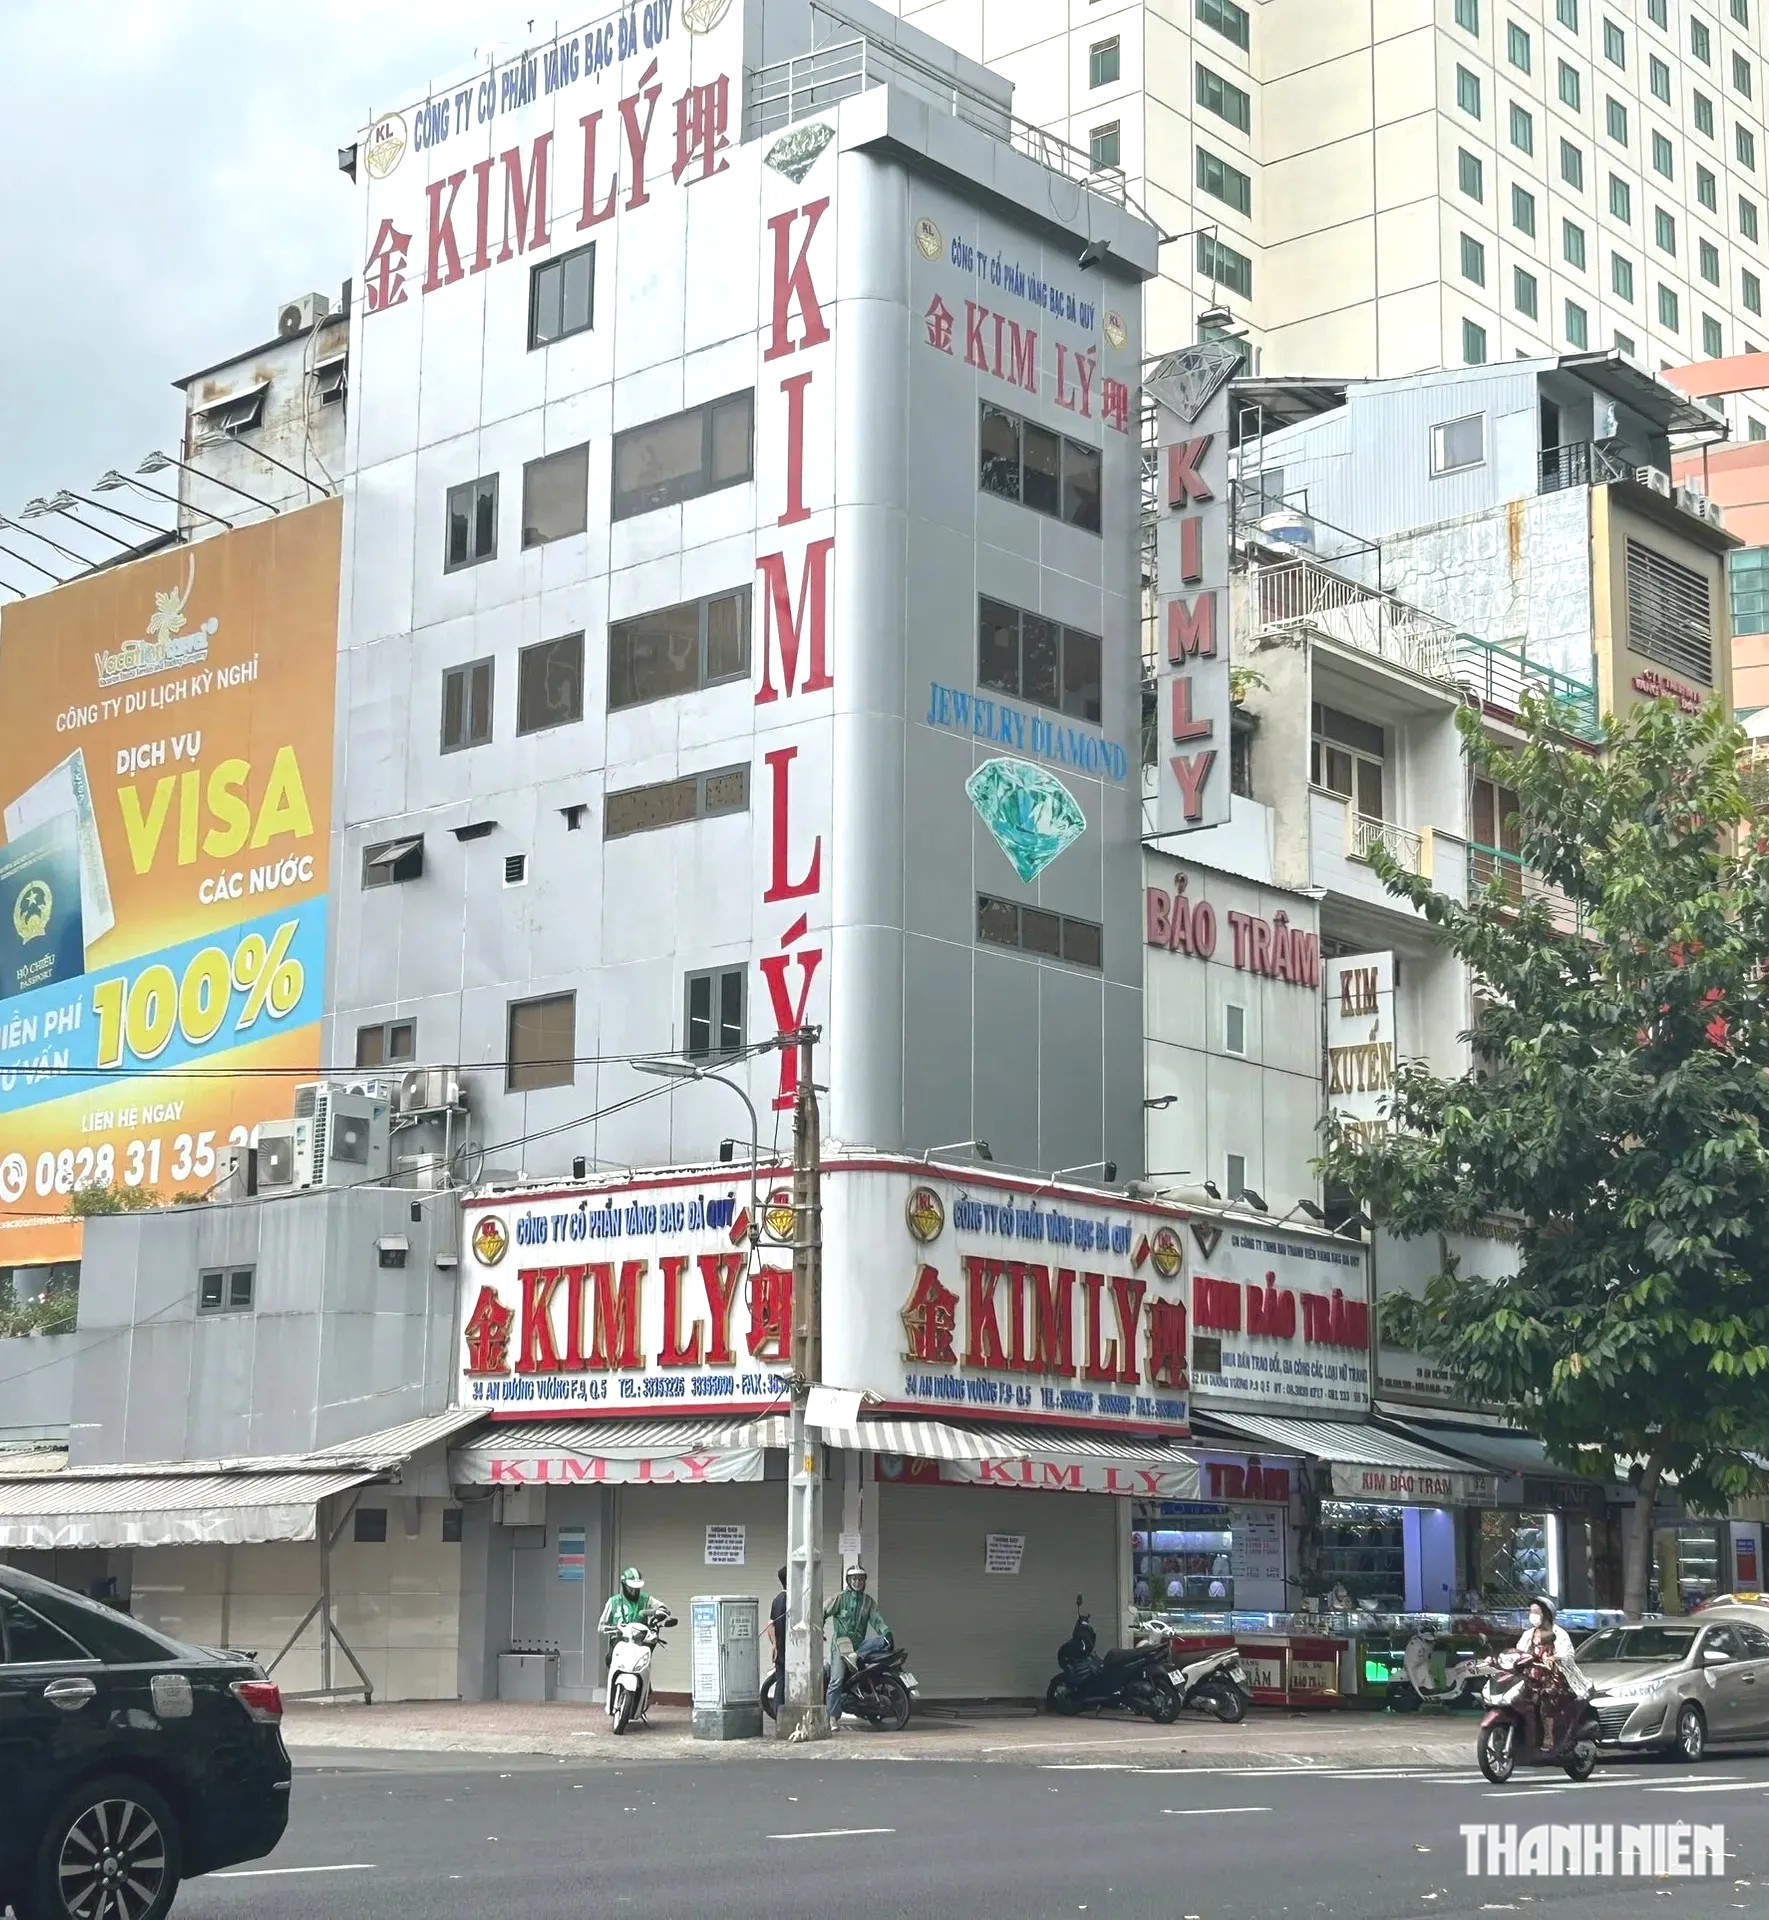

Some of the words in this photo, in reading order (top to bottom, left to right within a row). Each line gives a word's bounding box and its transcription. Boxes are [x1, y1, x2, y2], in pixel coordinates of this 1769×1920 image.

[455, 88, 474, 135] TY
[585, 22, 613, 84] BẠC
[375, 123, 394, 141] KL
[673, 73, 730, 187] 理
[422, 131, 554, 295] KIM
[577, 57, 663, 232] LÝ
[363, 218, 412, 318] 金
[977, 251, 987, 280] TY
[924, 293, 954, 356] 金
[964, 299, 1038, 394] KIM
[1055, 344, 1097, 419] LÝ
[755, 196, 835, 705] KIM
[1166, 434, 1217, 665] KIM
[56, 704, 98, 732] CÔNG
[101, 697, 122, 720] TY
[125, 690, 147, 714] DU
[150, 681, 187, 710] LỊCH
[191, 668, 213, 697] KỲ
[927, 681, 1026, 750] JEWELRY
[1031, 716, 1128, 782] DIAMOND
[116, 740, 166, 777] DỊCH
[171, 730, 202, 762] VỤ
[1170, 676, 1217, 822] LY
[117, 745, 314, 875] VISA
[199, 869, 244, 904] CÁC
[249, 853, 314, 894] NƯỚC
[759, 746, 823, 1111] LÝ
[1146, 872, 1217, 960] BẢO
[1228, 909, 1320, 988] TRÂM
[0, 1010, 38, 1050] IỄN
[43, 994, 83, 1038] PHÍ
[92, 918, 305, 1072] 100%
[1339, 967, 1379, 1018] KIM
[142, 1100, 184, 1124] NGAY
[35, 1143, 115, 1195] 0828
[124, 1138, 161, 1187] 31
[171, 1130, 217, 1181] 35
[551, 1213, 569, 1242] TY
[983, 1203, 999, 1235] TY
[515, 1258, 649, 1374] KIM
[657, 1206, 752, 1369] LÝ
[900, 1263, 959, 1365] 金
[960, 1255, 1077, 1378] KIM
[1080, 1233, 1151, 1386] LÝ
[1246, 1270, 1296, 1339] BẢO
[1300, 1287, 1369, 1350] TRÂM
[463, 1285, 516, 1376] 金
[486, 1380, 500, 1401] AN
[919, 1375, 933, 1398] AN
[488, 1458, 608, 1483] KIM
[977, 1457, 1085, 1490] KIM
[1103, 1464, 1168, 1495] LÝ
[1362, 1472, 1386, 1491] KIM
